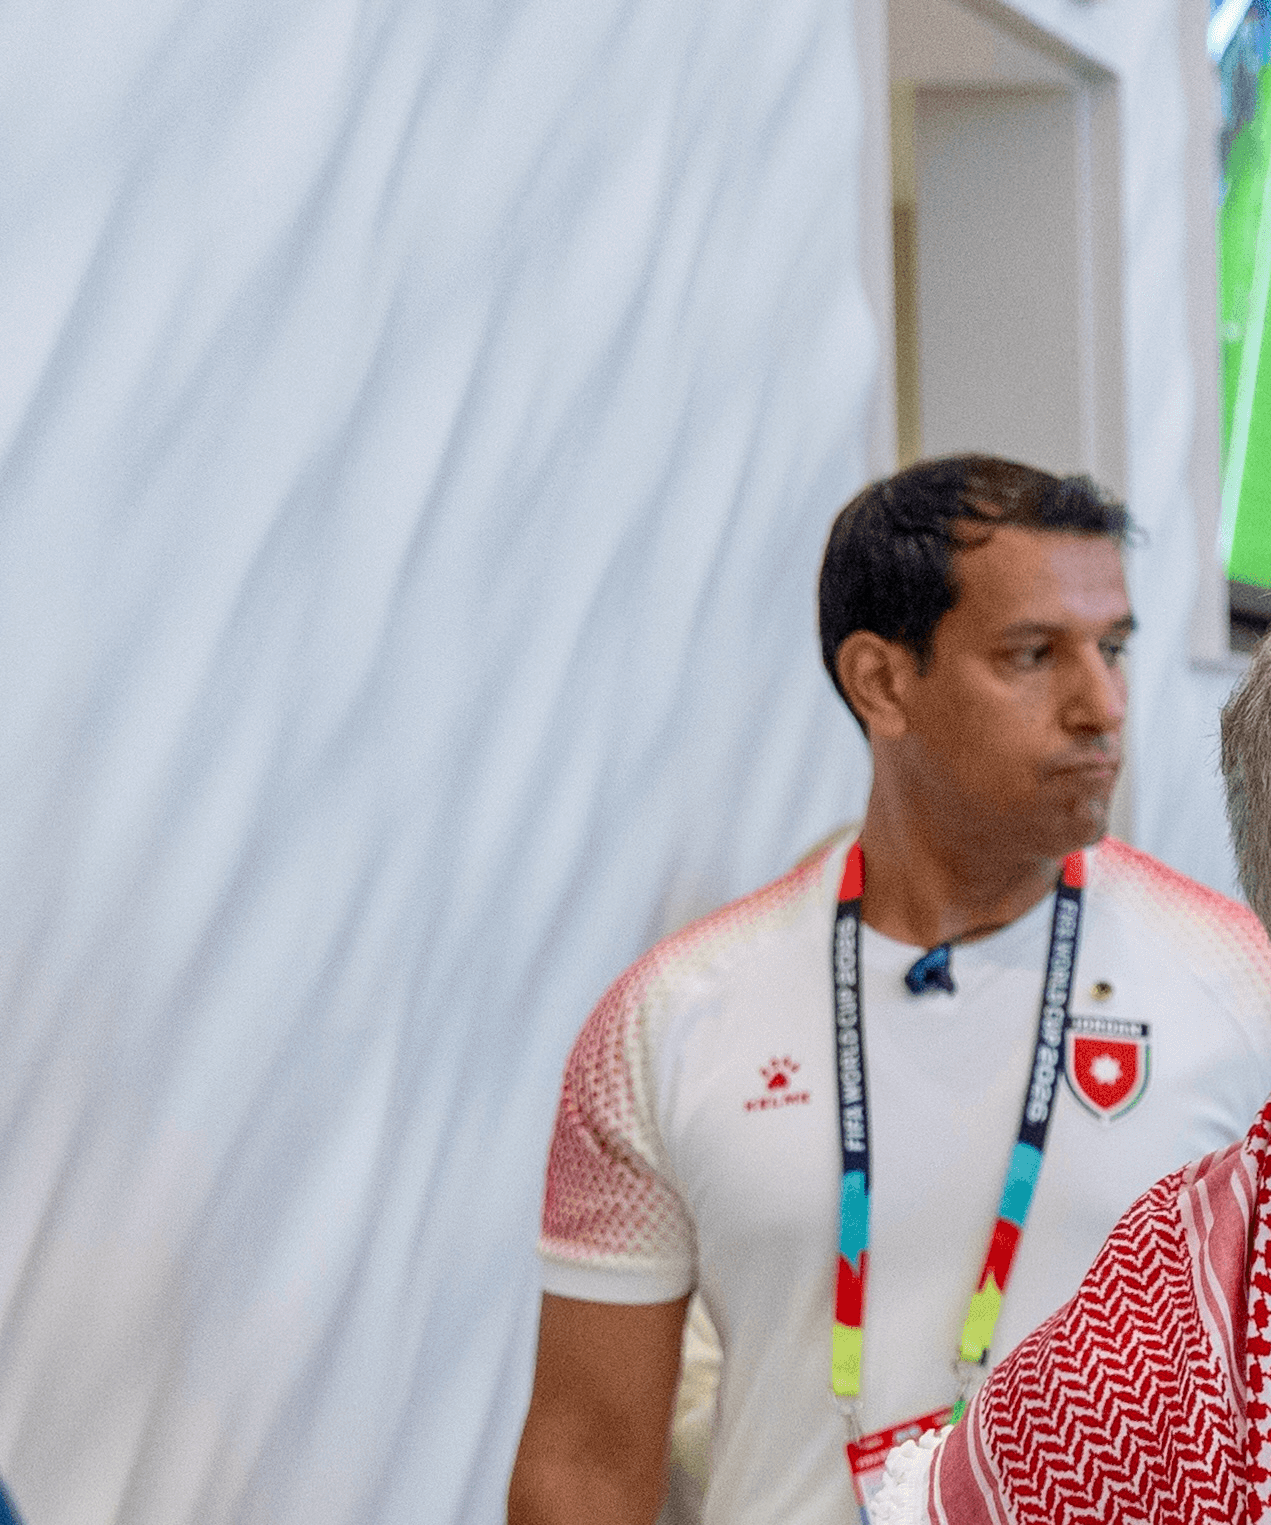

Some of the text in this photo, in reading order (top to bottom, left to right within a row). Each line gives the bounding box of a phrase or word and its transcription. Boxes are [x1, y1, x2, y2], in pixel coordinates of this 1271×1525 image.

[1046, 940, 1073, 1006] WORLD
[834, 914, 866, 1152] FIFA WORLD CUP 2026
[1041, 1004, 1066, 1048] CUP
[1025, 1046, 1059, 1123] 2026
